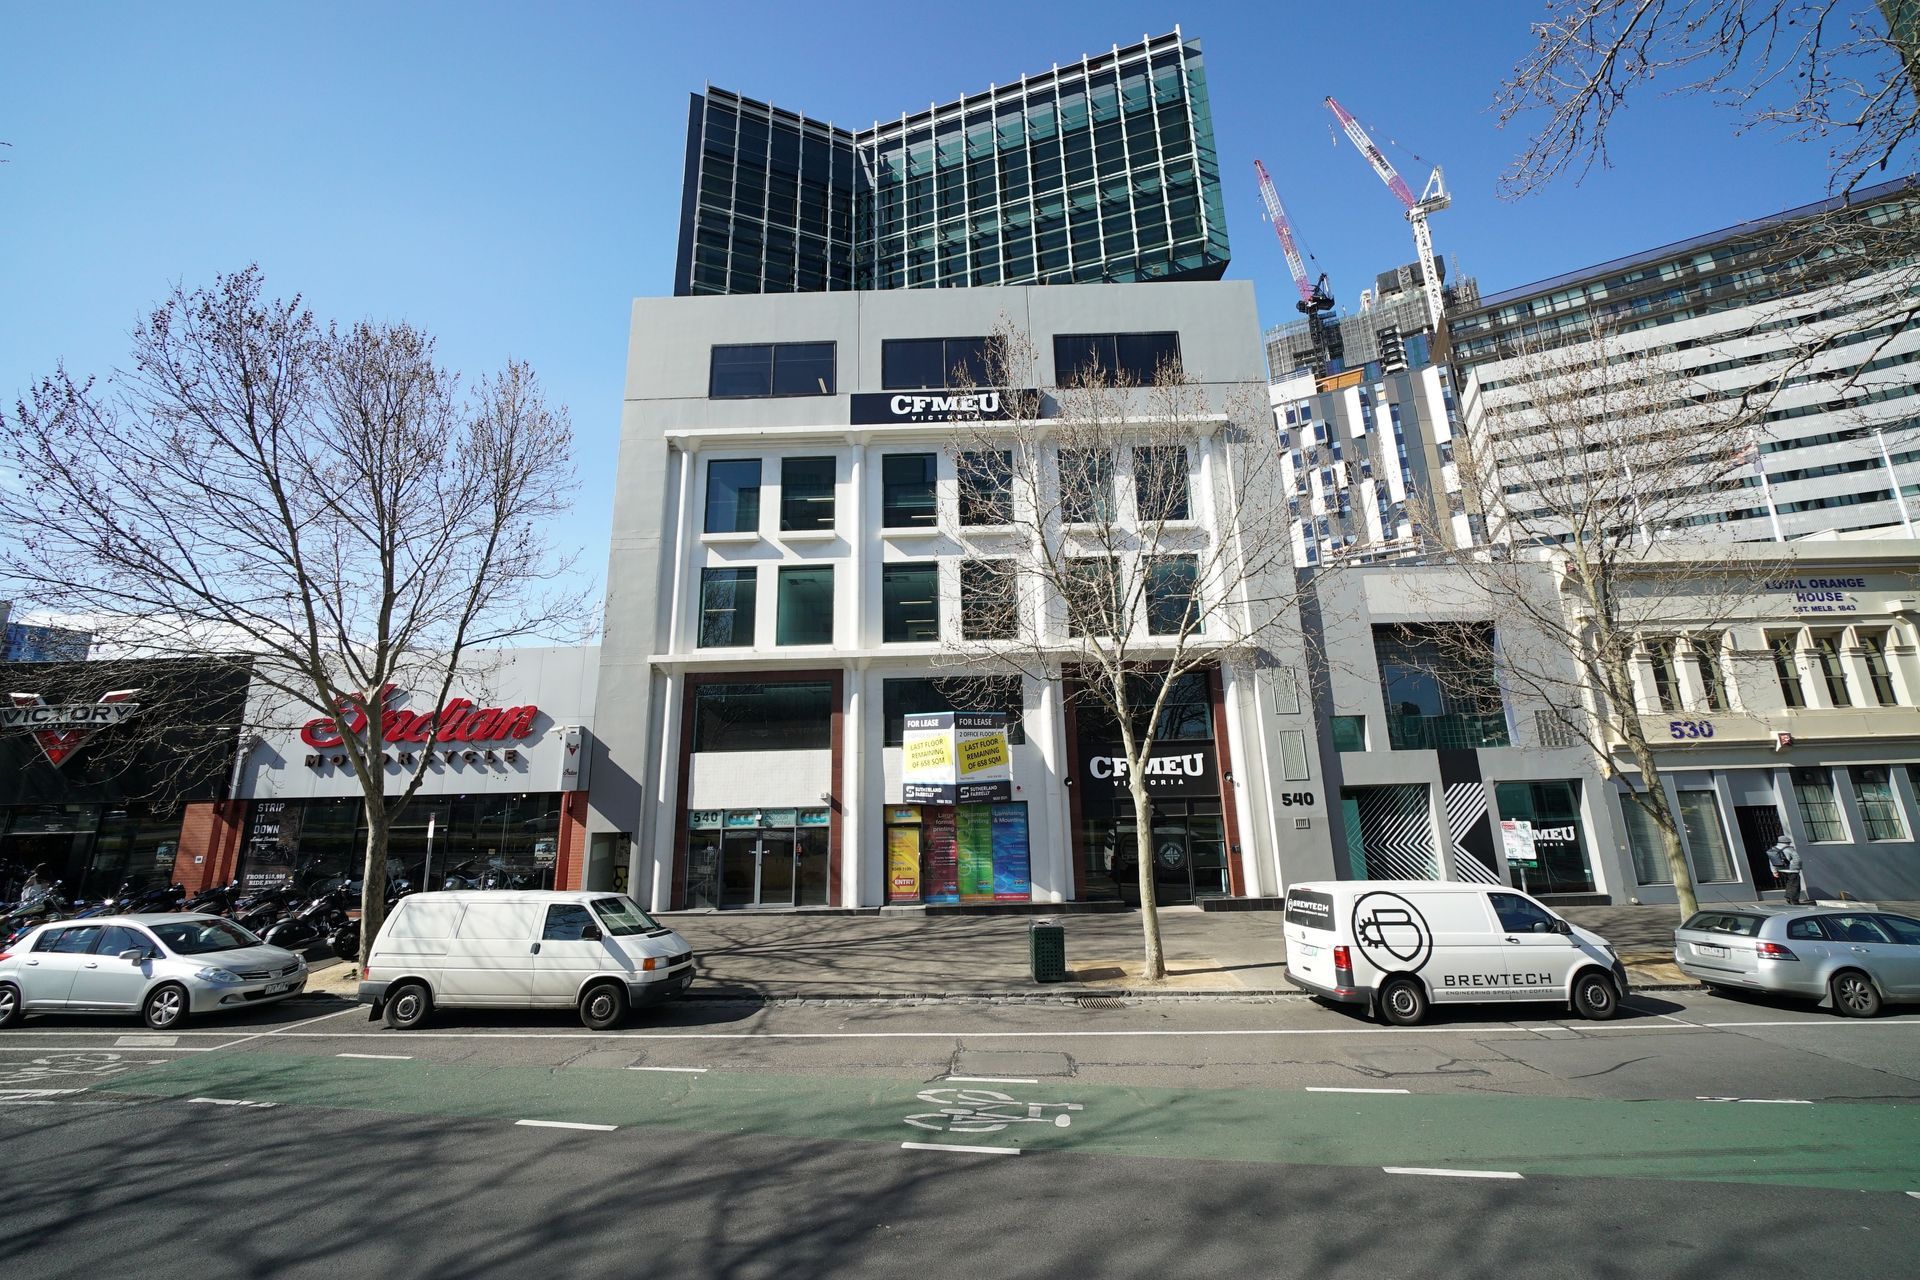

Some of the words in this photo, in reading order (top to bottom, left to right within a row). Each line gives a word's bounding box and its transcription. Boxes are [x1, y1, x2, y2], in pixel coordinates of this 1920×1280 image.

[890, 393, 1000, 415] CFMEU
[1765, 579, 1807, 590] LOYAL
[1809, 578, 1866, 589] ORANGE
[1796, 592, 1844, 602] HOUSE
[300, 684, 538, 747] Indian
[907, 720, 919, 728] FOR
[921, 719, 939, 727] LEASE
[974, 718, 992, 726] LEASE
[1669, 720, 1714, 739] 530
[911, 742, 924, 751] LAST
[925, 739, 943, 749] FLOOR
[964, 742, 979, 751] LAST
[980, 738, 998, 749] FLOOR
[912, 748, 944, 759] REMAINING
[966, 747, 1000, 760] REMAINING
[932, 757, 945, 765] SQM
[977, 760, 988, 768] 658
[988, 756, 1002, 765] SQM
[1113, 779, 1184, 787] VIORIA
[1282, 792, 1315, 807] 540
[258, 803, 285, 813] STRIP
[255, 814, 265, 823] IT
[693, 812, 718, 823] 540
[253, 825, 279, 834] DOWN
[1532, 826, 1575, 841] MEU
[1293, 899, 1329, 912] BREWTECH
[1444, 973, 1552, 986] BREWTECH
